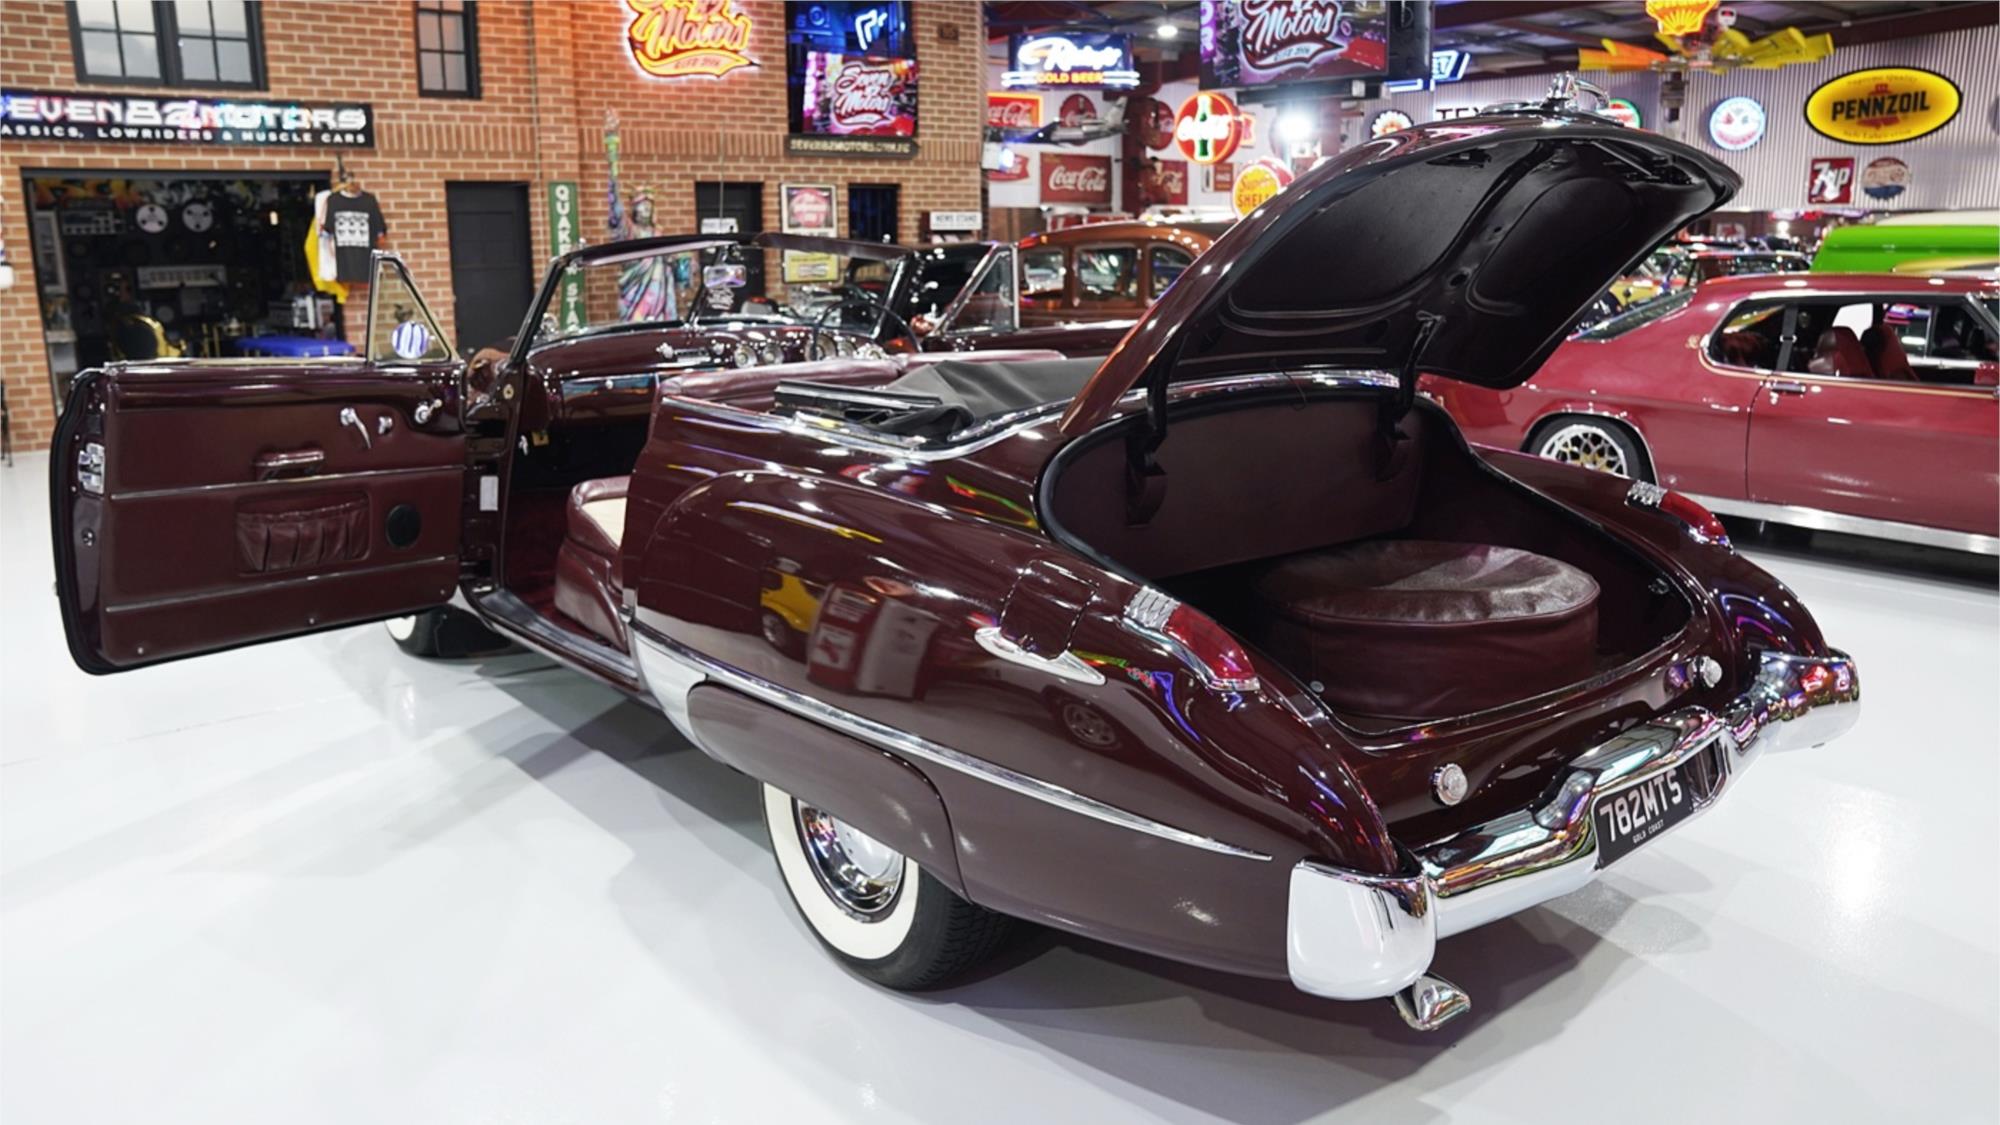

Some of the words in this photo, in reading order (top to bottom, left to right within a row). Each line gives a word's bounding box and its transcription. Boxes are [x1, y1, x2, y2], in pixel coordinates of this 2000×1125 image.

[1246, 5, 1334, 53] Motors
[1036, 71, 1069, 84] COLD
[1071, 71, 1104, 84] BEER
[1832, 91, 1930, 121] PENNZOIL
[97, 127, 213, 141] LOWRIDERS
[241, 131, 312, 143] MUSCLE
[320, 132, 366, 144] CARS
[1600, 768, 1682, 842] 782MTS
